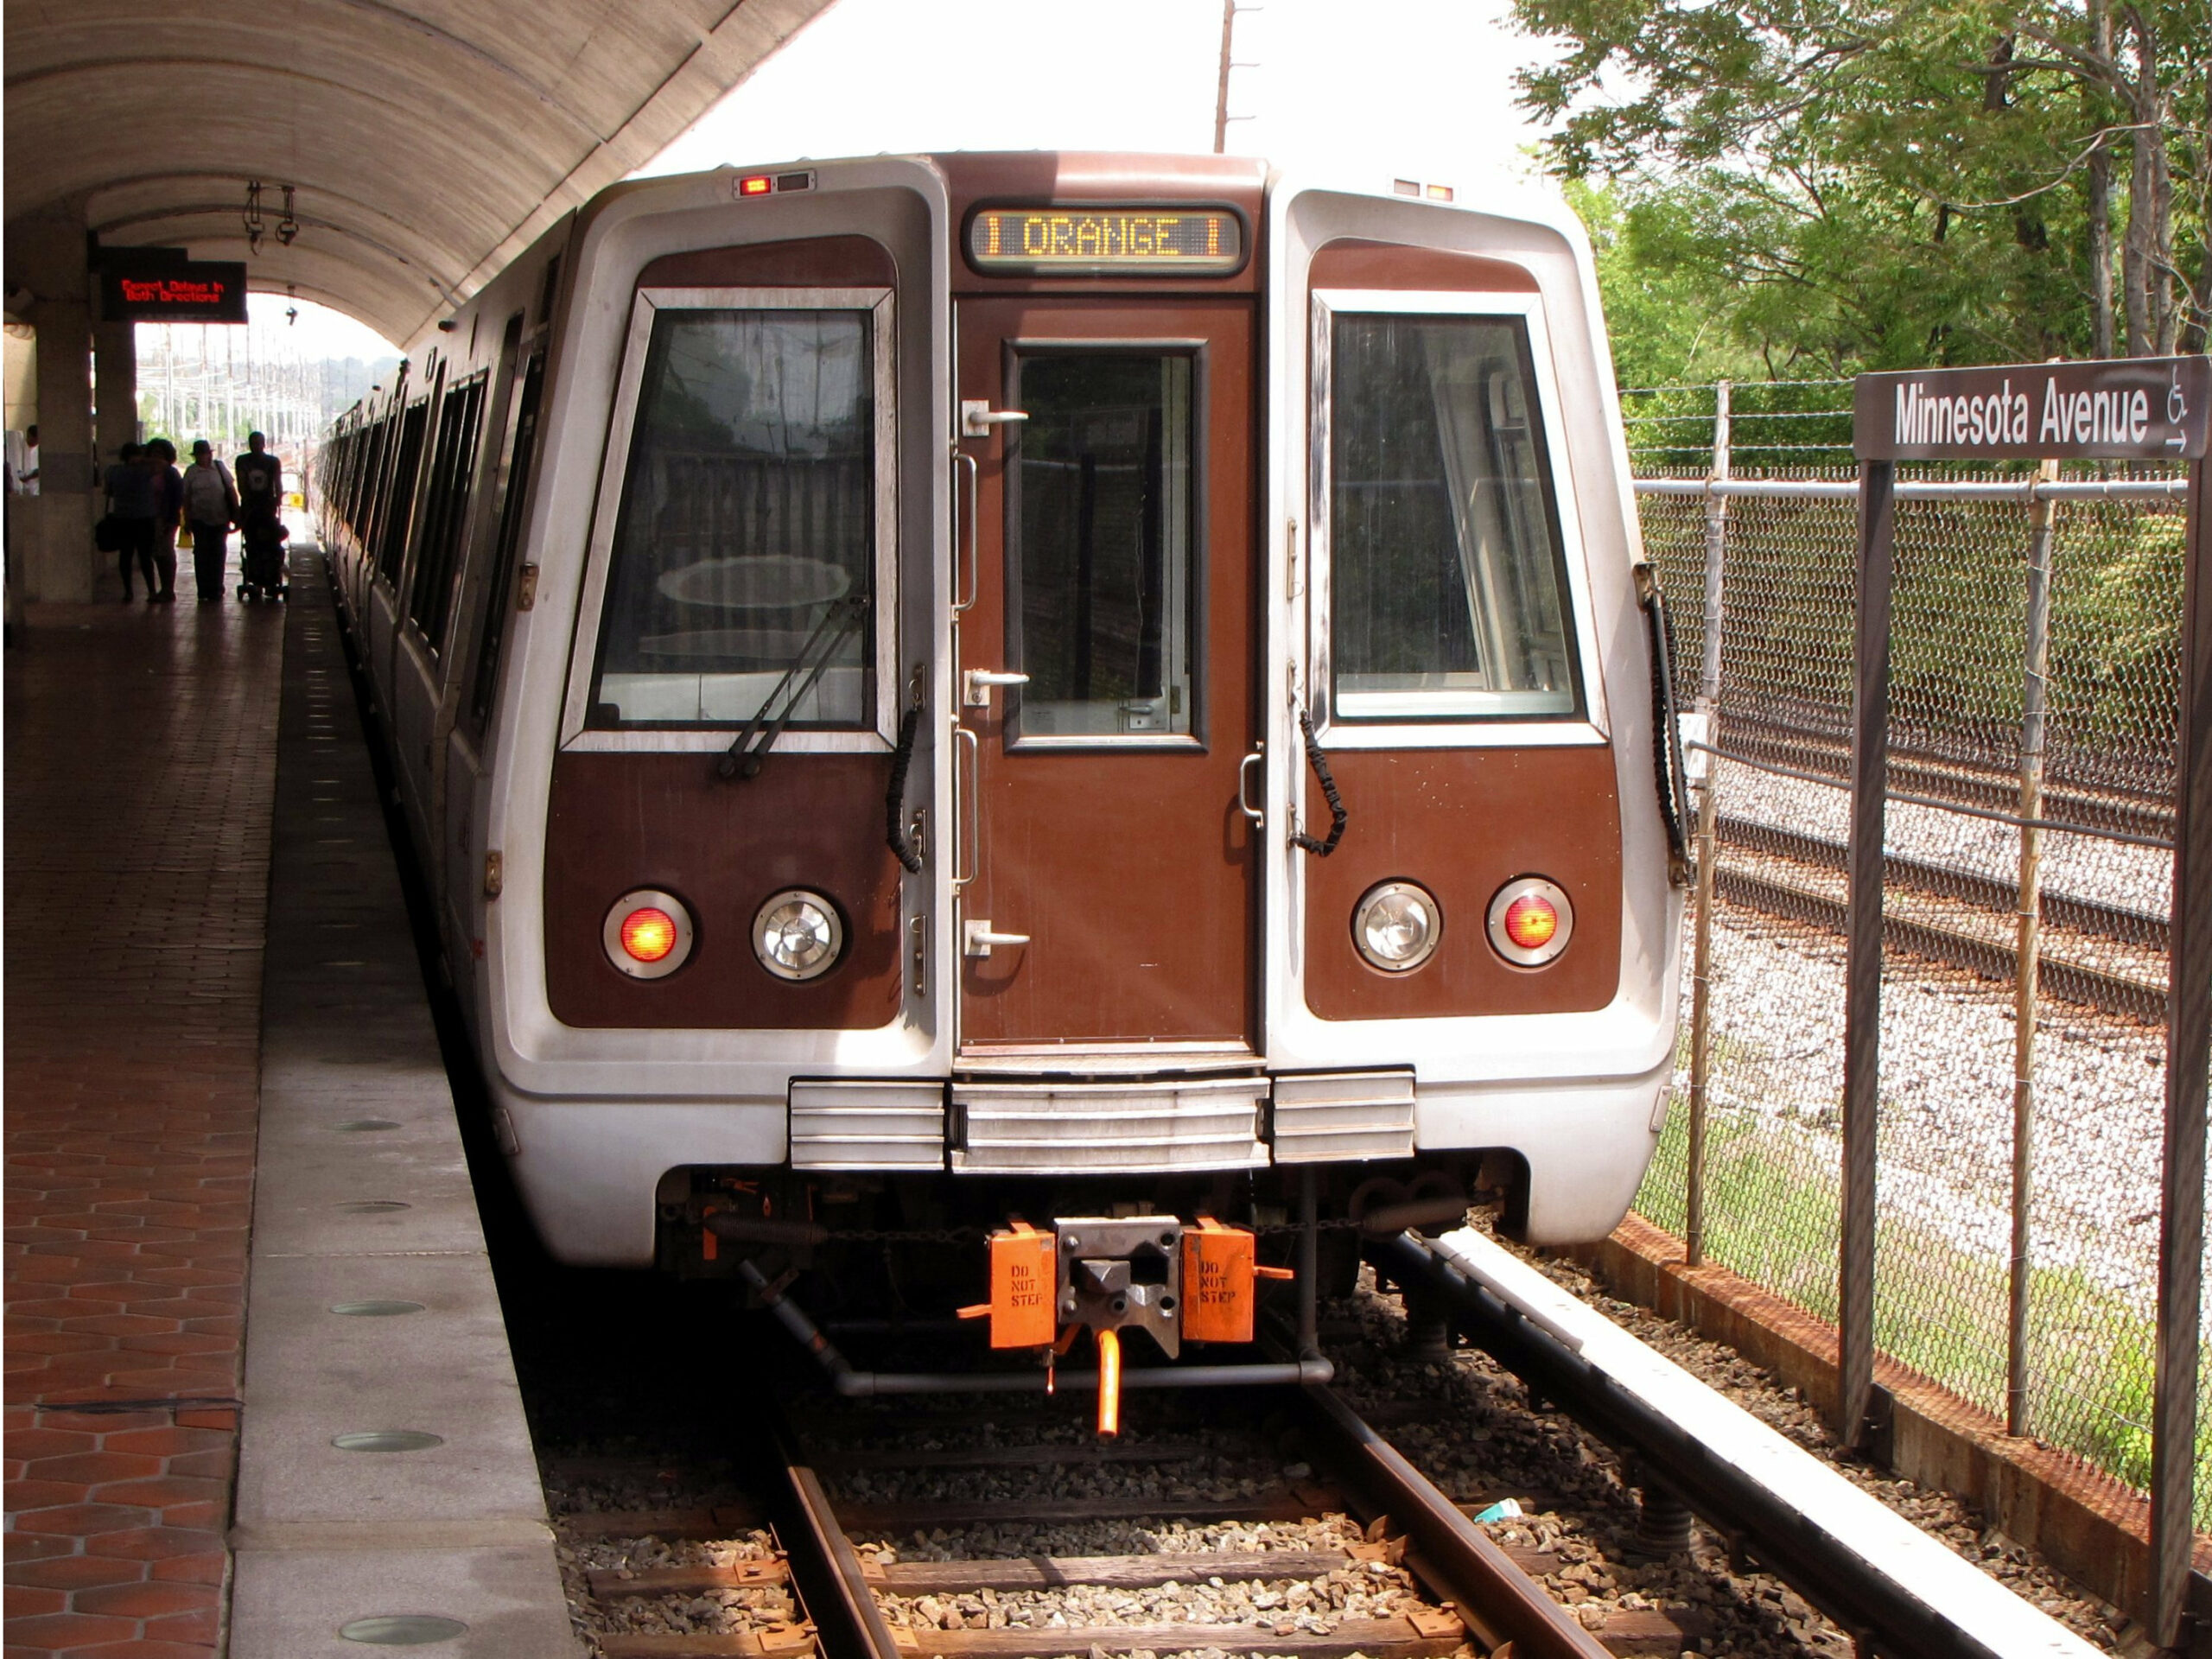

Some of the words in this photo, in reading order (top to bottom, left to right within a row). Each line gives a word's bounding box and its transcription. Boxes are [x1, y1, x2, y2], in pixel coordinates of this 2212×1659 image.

[1023, 217, 1179, 256] ORANGE
[126, 290, 156, 301] Both
[160, 291, 219, 302] Directions
[1895, 378, 2028, 444] Minnesota
[2039, 377, 2148, 444] Avenue
[1011, 1265, 1029, 1277] DO
[1202, 1262, 1218, 1274] DO
[1011, 1279, 1036, 1292] NOT
[1201, 1276, 1227, 1288] NOT
[1011, 1293, 1043, 1306] STEP
[1201, 1291, 1236, 1303] STEP
